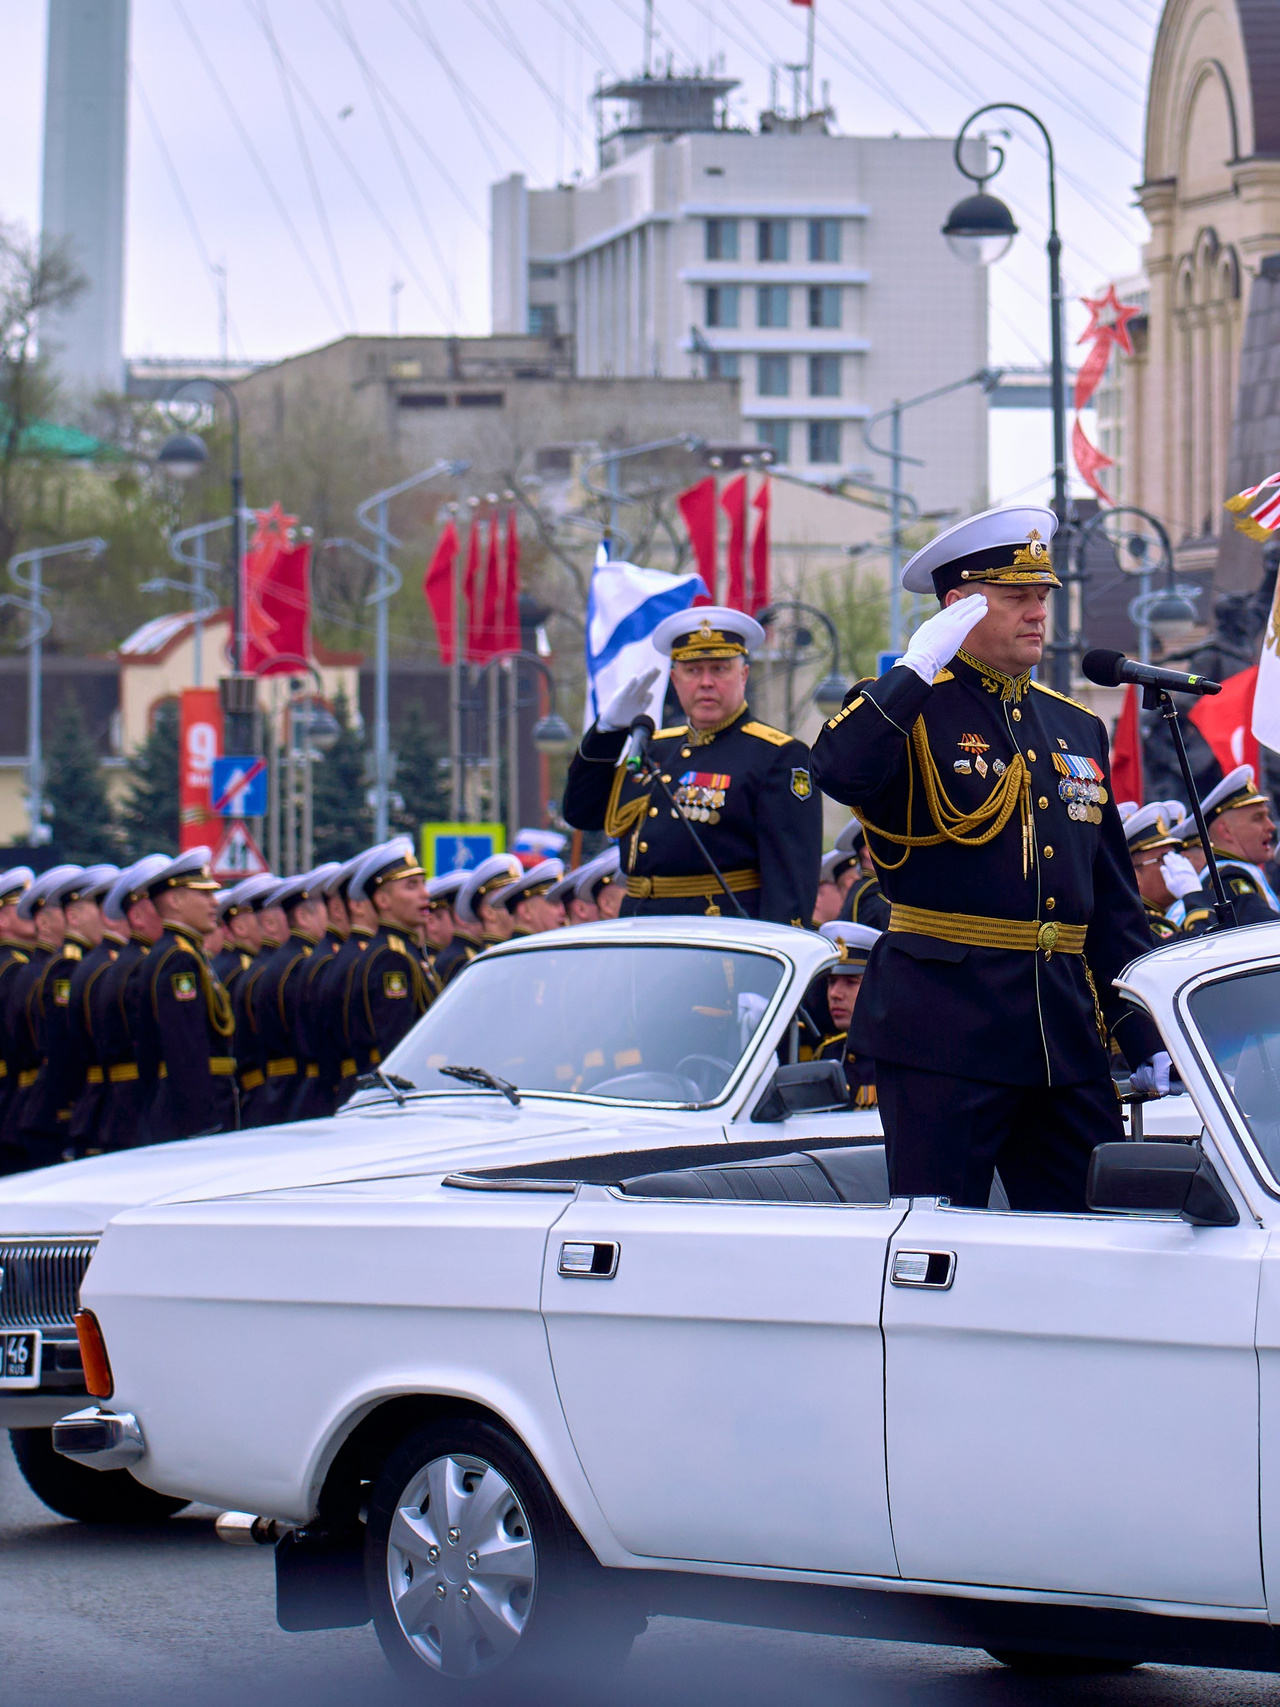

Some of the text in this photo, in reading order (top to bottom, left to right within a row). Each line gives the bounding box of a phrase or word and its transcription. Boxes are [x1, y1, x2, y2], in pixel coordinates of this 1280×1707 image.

[187, 721, 217, 770] 9
[8, 1336, 28, 1364] 46
[8, 1364, 26, 1375] RUS
